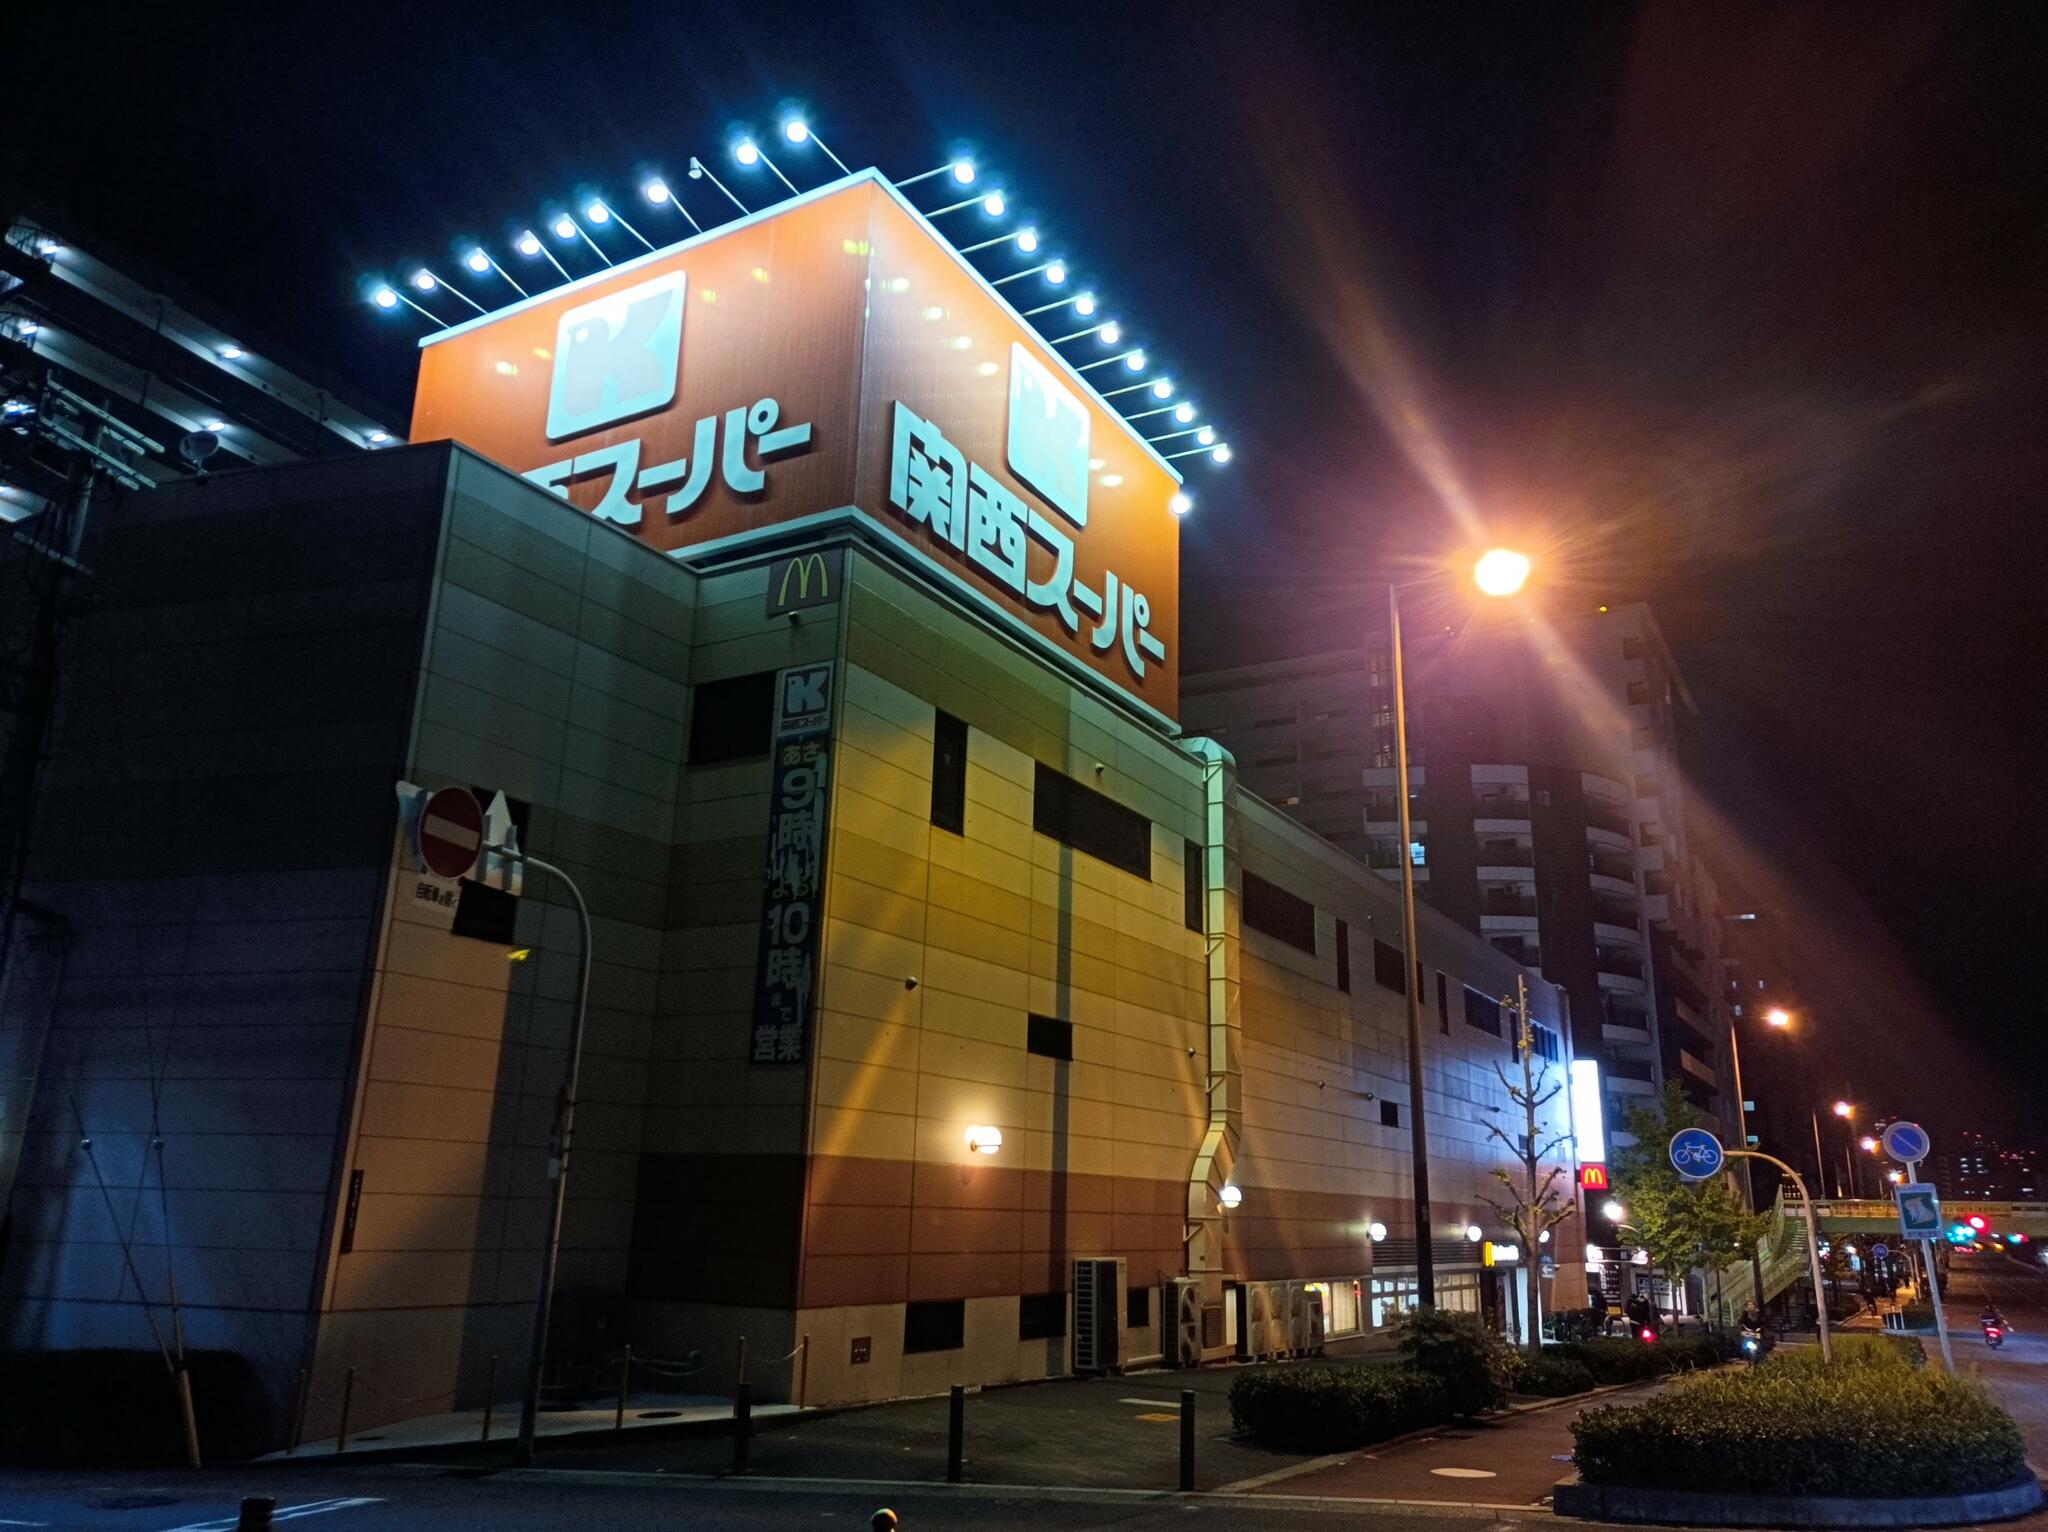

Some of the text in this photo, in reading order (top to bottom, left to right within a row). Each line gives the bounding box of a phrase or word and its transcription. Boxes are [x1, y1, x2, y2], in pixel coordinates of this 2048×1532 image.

[890, 400, 1165, 678] 関西スーパー
